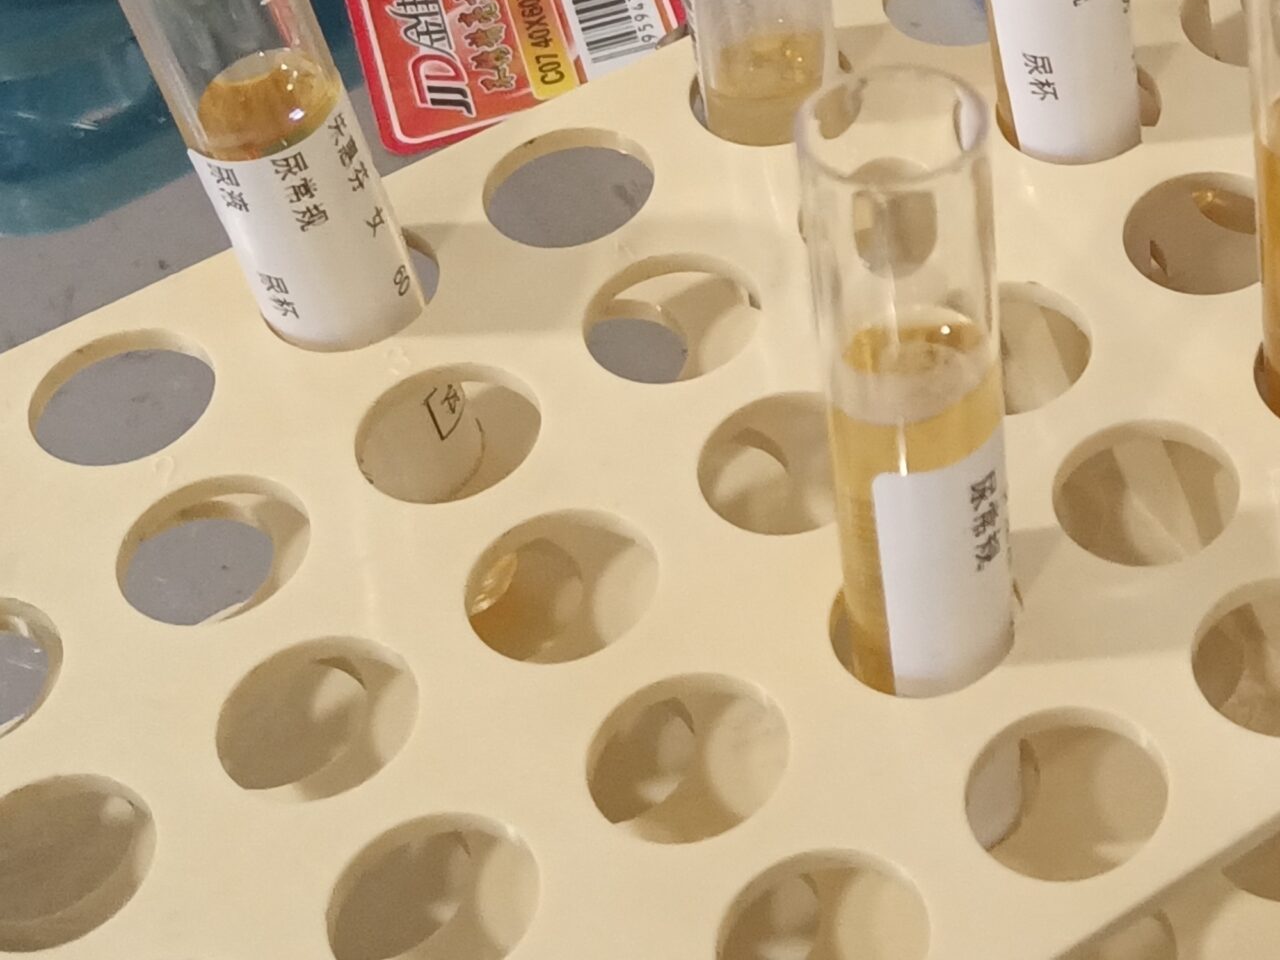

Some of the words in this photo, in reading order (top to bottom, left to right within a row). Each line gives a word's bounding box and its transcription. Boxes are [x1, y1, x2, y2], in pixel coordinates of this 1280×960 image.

[535, 53, 566, 86] C07
[1021, 52, 1060, 102] 尿杯
[207, 162, 251, 215] 尿液
[270, 151, 330, 233] 尿常规
[365, 205, 387, 239] 女
[256, 269, 301, 321] 尿杯
